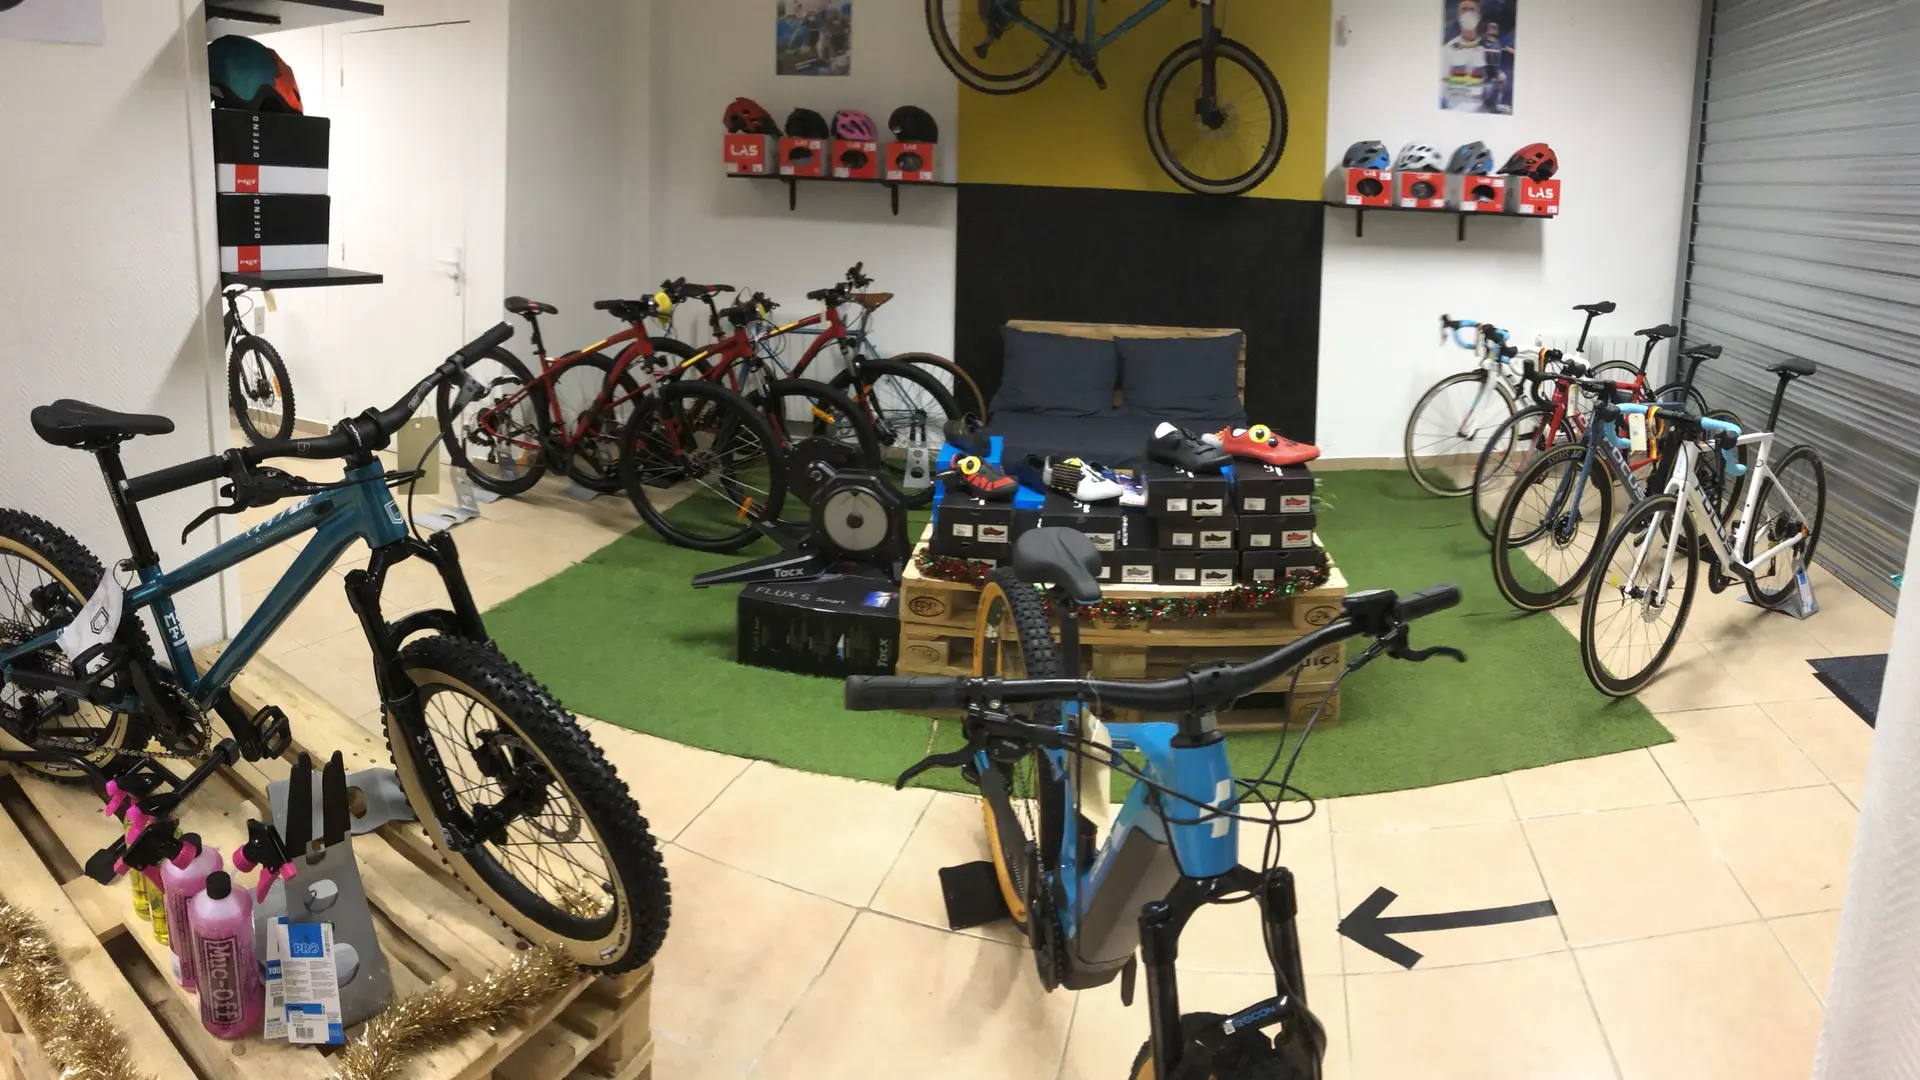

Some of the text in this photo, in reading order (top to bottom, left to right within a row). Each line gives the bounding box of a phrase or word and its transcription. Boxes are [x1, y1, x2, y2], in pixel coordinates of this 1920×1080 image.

[730, 145, 758, 157] LAS
[1528, 187, 1554, 199] LAS
[773, 567, 804, 578] Tacx
[756, 586, 797, 599] FLUX
[799, 593, 811, 601] S
[877, 637, 892, 668] Tacx
[208, 944, 240, 1021] Muc-Off
